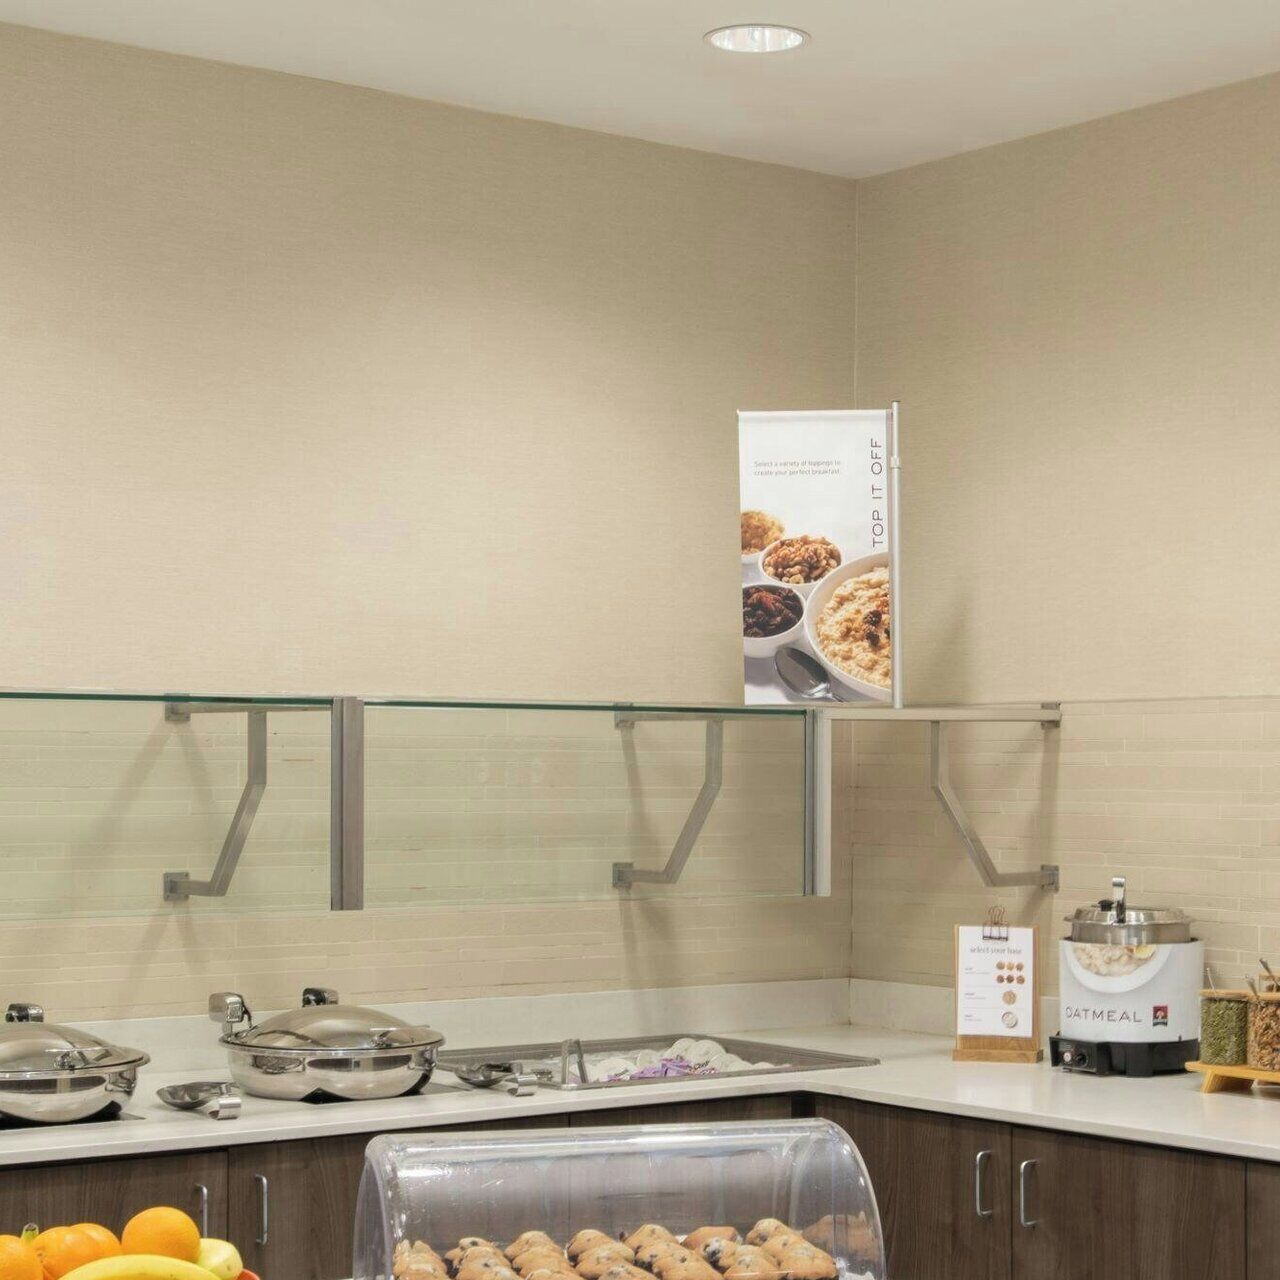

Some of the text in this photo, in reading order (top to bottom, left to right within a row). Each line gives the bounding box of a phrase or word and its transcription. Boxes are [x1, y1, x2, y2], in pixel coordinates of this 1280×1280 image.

[870, 438, 884, 548] TOP IT OFF
[1065, 1005, 1143, 1023] OATMEAL
